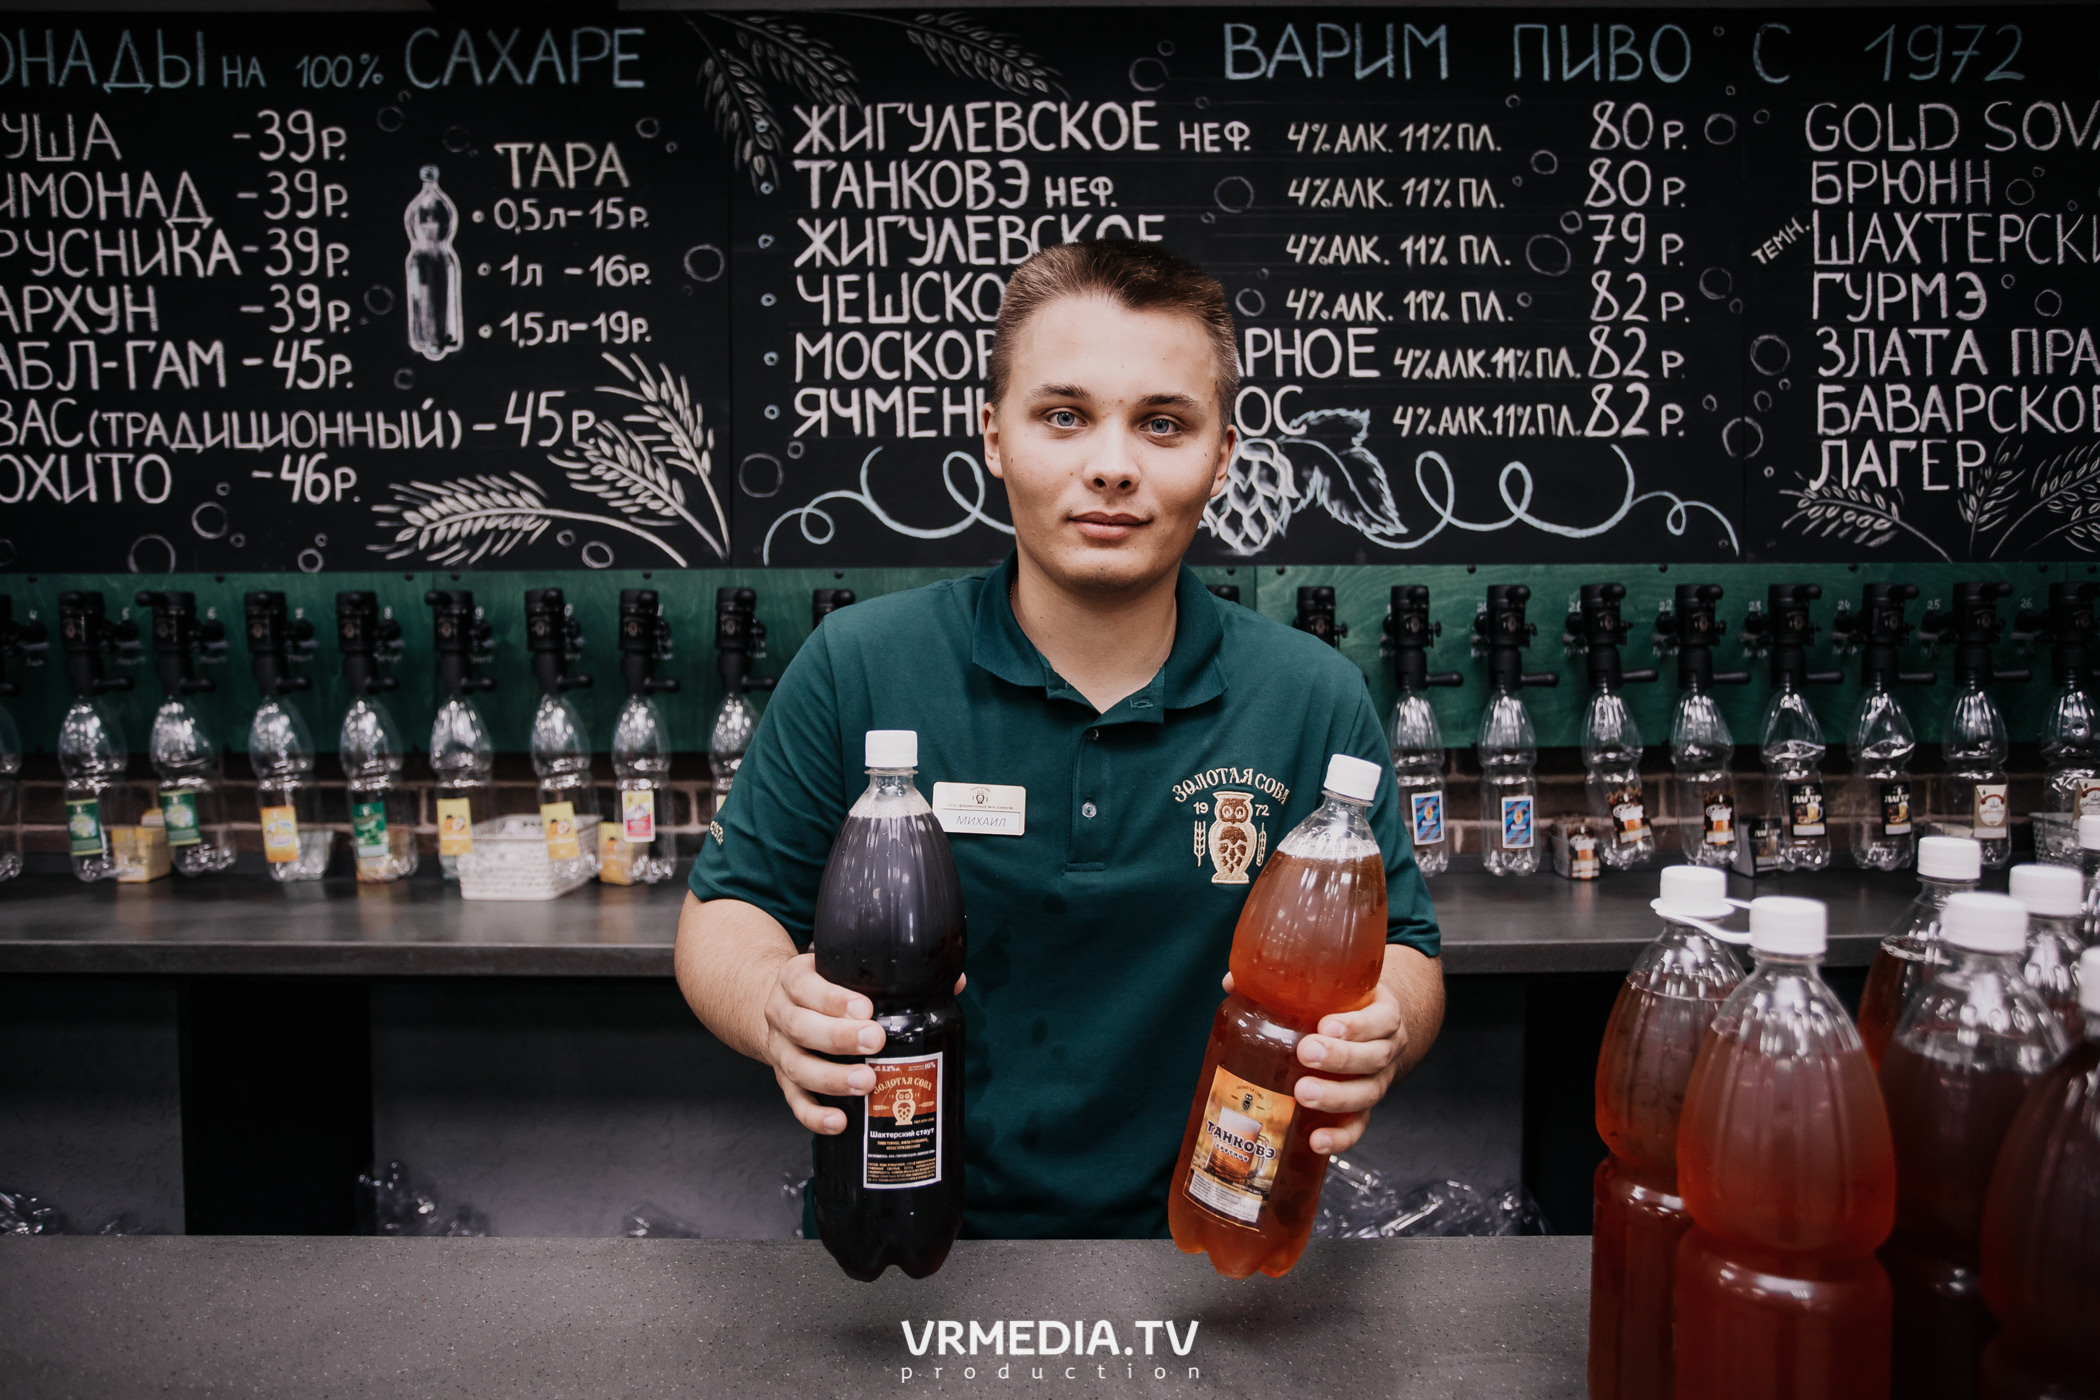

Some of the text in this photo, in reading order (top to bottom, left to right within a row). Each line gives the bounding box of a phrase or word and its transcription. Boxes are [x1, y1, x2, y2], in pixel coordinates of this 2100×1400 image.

[221, 55, 267, 89] НА
[295, 53, 384, 89] 100%
[405, 26, 646, 90] САХАРЕ
[1224, 22, 2025, 85] ВАРИМ ПИВО С 1972
[792, 100, 1161, 154] ЖИГУЛЕВСКОЕ
[1179, 120, 1251, 153] НЕФ.
[1804, 102, 1960, 153] GOLD
[493, 142, 630, 190] ТАРА
[792, 158, 1030, 211] ТАНКОВЭ
[1044, 175, 1118, 209] НЕФ.
[1811, 158, 1991, 206] БРЮНН
[1812, 270, 1988, 323] ГУРМЭ
[1815, 326, 1989, 378] ЗЛАТА
[1808, 439, 1986, 491] ЛАГЕР
[1172, 767, 1290, 805] ЗОЛОТАЯ СОВА
[1193, 802, 1270, 816] 19 72
[874, 1077, 932, 1094] ЗОЛОТАЯ СОВА
[870, 1127, 935, 1139] Шахтерский стаут
[1207, 1120, 1276, 1159] ТАНКОВЭ
